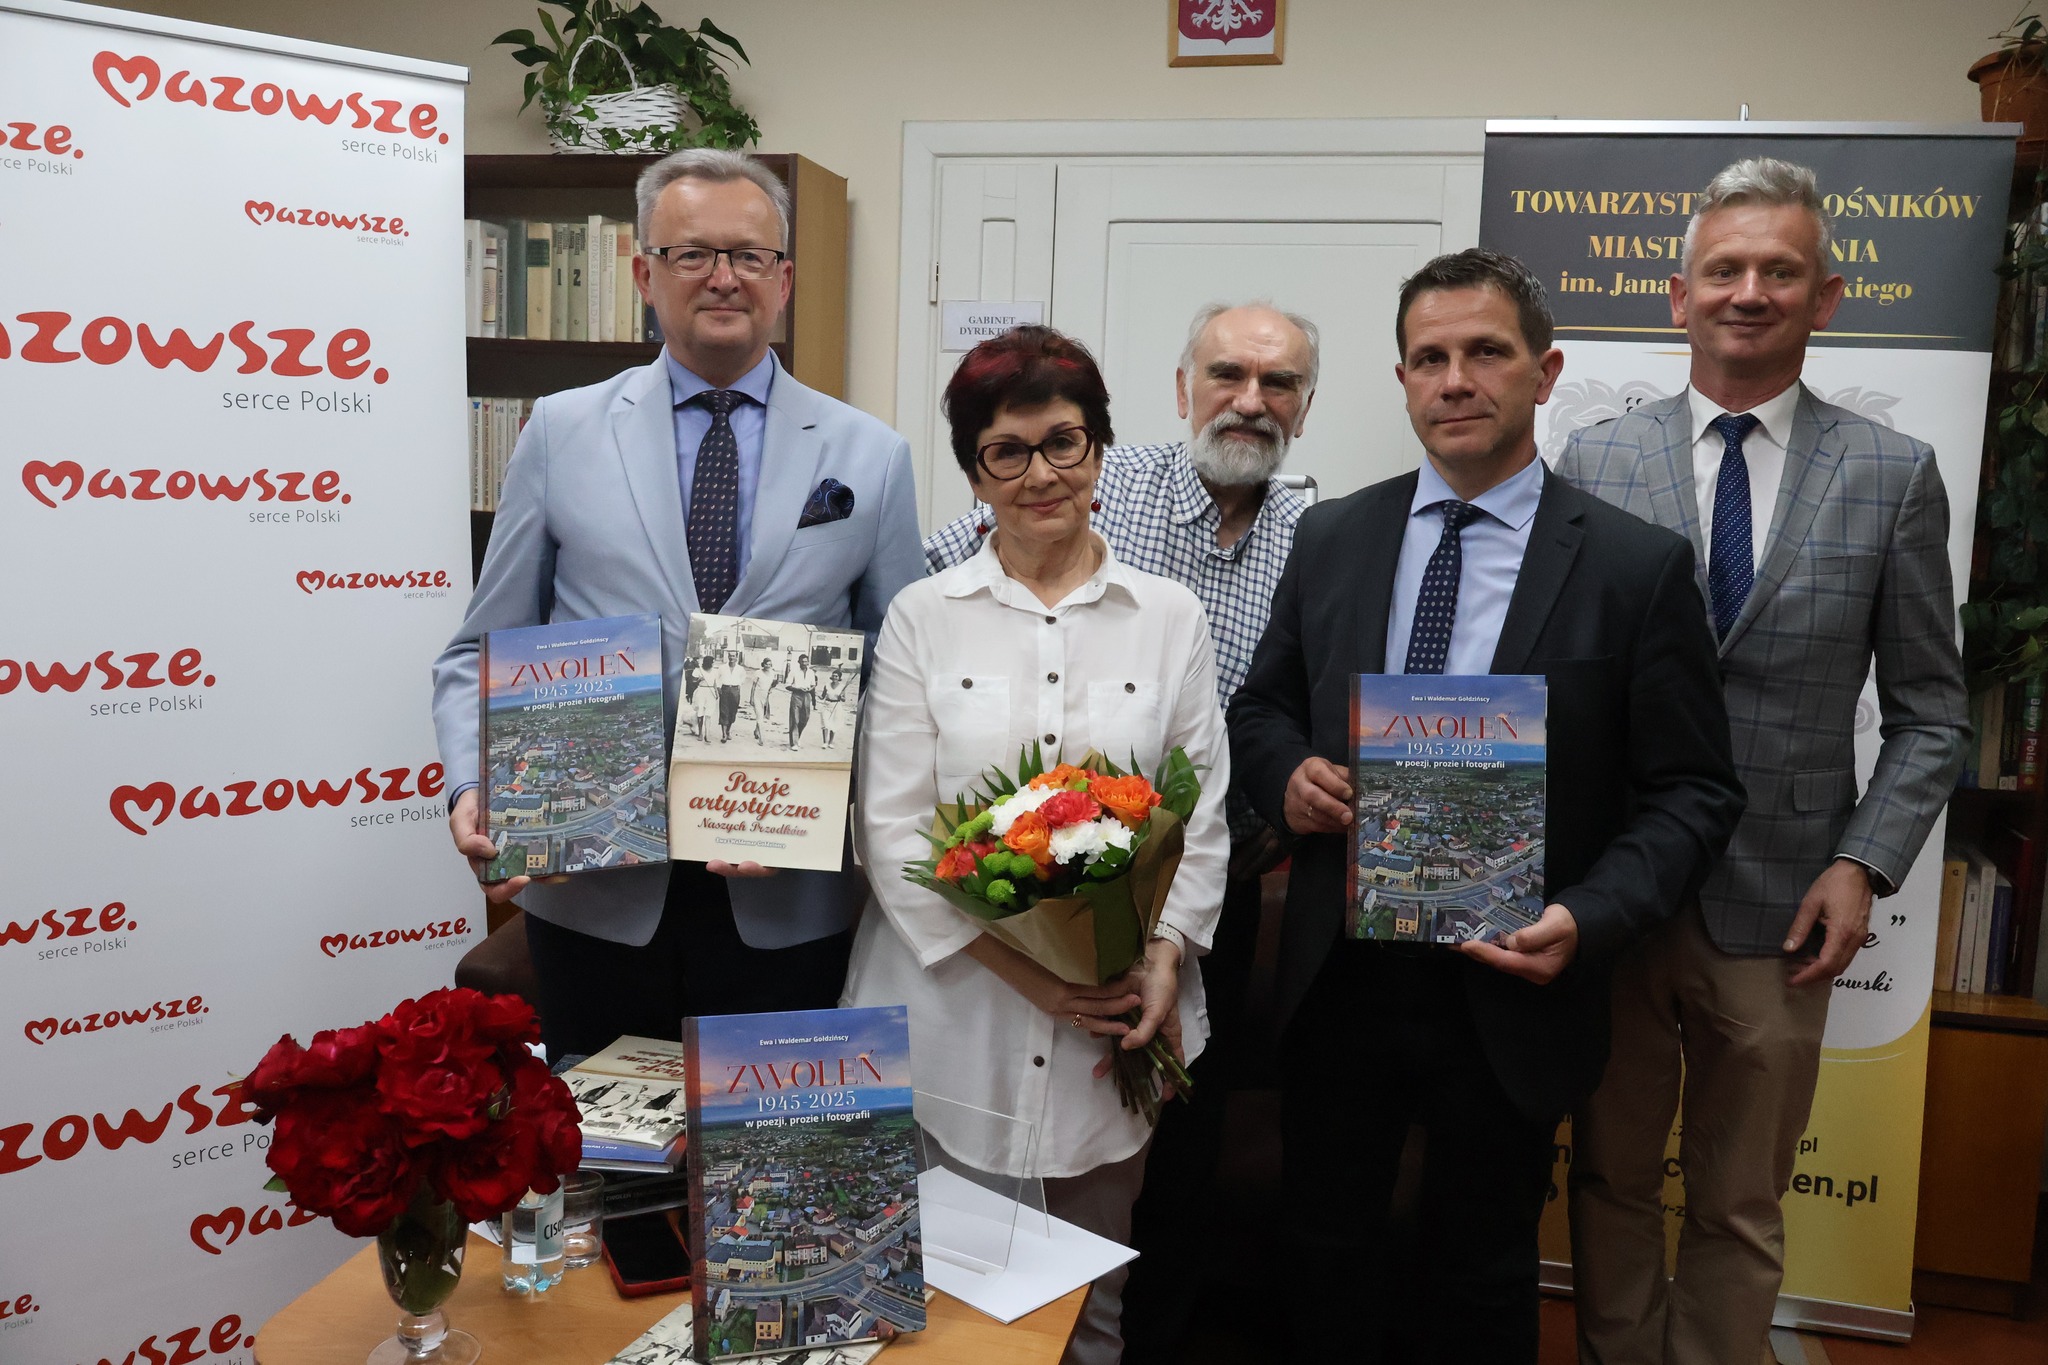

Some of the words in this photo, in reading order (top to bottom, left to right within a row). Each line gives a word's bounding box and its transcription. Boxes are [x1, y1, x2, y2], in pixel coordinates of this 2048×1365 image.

[342, 140, 387, 155] serce
[392, 143, 438, 164] Polski
[27, 158, 73, 176] Polski
[1511, 190, 1702, 215] TOWARZYST
[1822, 186, 1982, 219] OŚNIKÓW
[357, 235, 379, 245] serce
[380, 235, 404, 247] Polski
[1588, 235, 1683, 260] MIAST
[1560, 271, 1603, 293] im.
[1609, 272, 1671, 297] Jana
[959, 327, 1009, 336] DYREKTO
[969, 316, 1016, 325] GABINET
[0, 312, 389, 384] zowsze.
[223, 392, 290, 410] serce
[301, 391, 371, 413] Polski
[249, 512, 290, 523] serce
[296, 509, 341, 523] Polski
[426, 590, 447, 599] Polski
[510, 647, 636, 687] ZWOLEŃ
[91, 702, 141, 717] serce
[149, 695, 203, 712] Polski
[532, 702, 557, 713] poezji,
[558, 699, 583, 710] prozie
[588, 693, 625, 705] fotografii
[1382, 710, 1520, 740] ZWOLEŃ
[2028, 698, 2040, 733] Barwy
[1407, 742, 1493, 757] 1945-2025
[2025, 738, 2038, 773] Polski
[1405, 760, 1432, 769] poezji,
[1434, 760, 1459, 769] prozie
[1466, 760, 1505, 770] fotografii
[724, 771, 790, 802] Pasje
[351, 813, 394, 828] serce
[401, 805, 446, 823] Polski
[689, 794, 821, 821] artystyczne
[697, 817, 747, 833] Naszych
[750, 822, 808, 837] Przodków
[39, 946, 79, 961] serce
[84, 936, 127, 954] Polski
[425, 942, 446, 951] serce
[446, 936, 467, 947] Polski
[150, 1023, 175, 1033] serce
[176, 1016, 203, 1030] Polski
[779, 1037, 812, 1045] Waldemar
[726, 1049, 883, 1094] ZWOLEŃ
[758, 1090, 856, 1113] 1945-2025
[745, 1120, 754, 1128] w
[756, 1117, 787, 1129] poezji,
[789, 1113, 819, 1126] prozie
[826, 1110, 871, 1122] fotografii
[173, 1142, 233, 1169] serce
[4, 1317, 33, 1331] Polski
